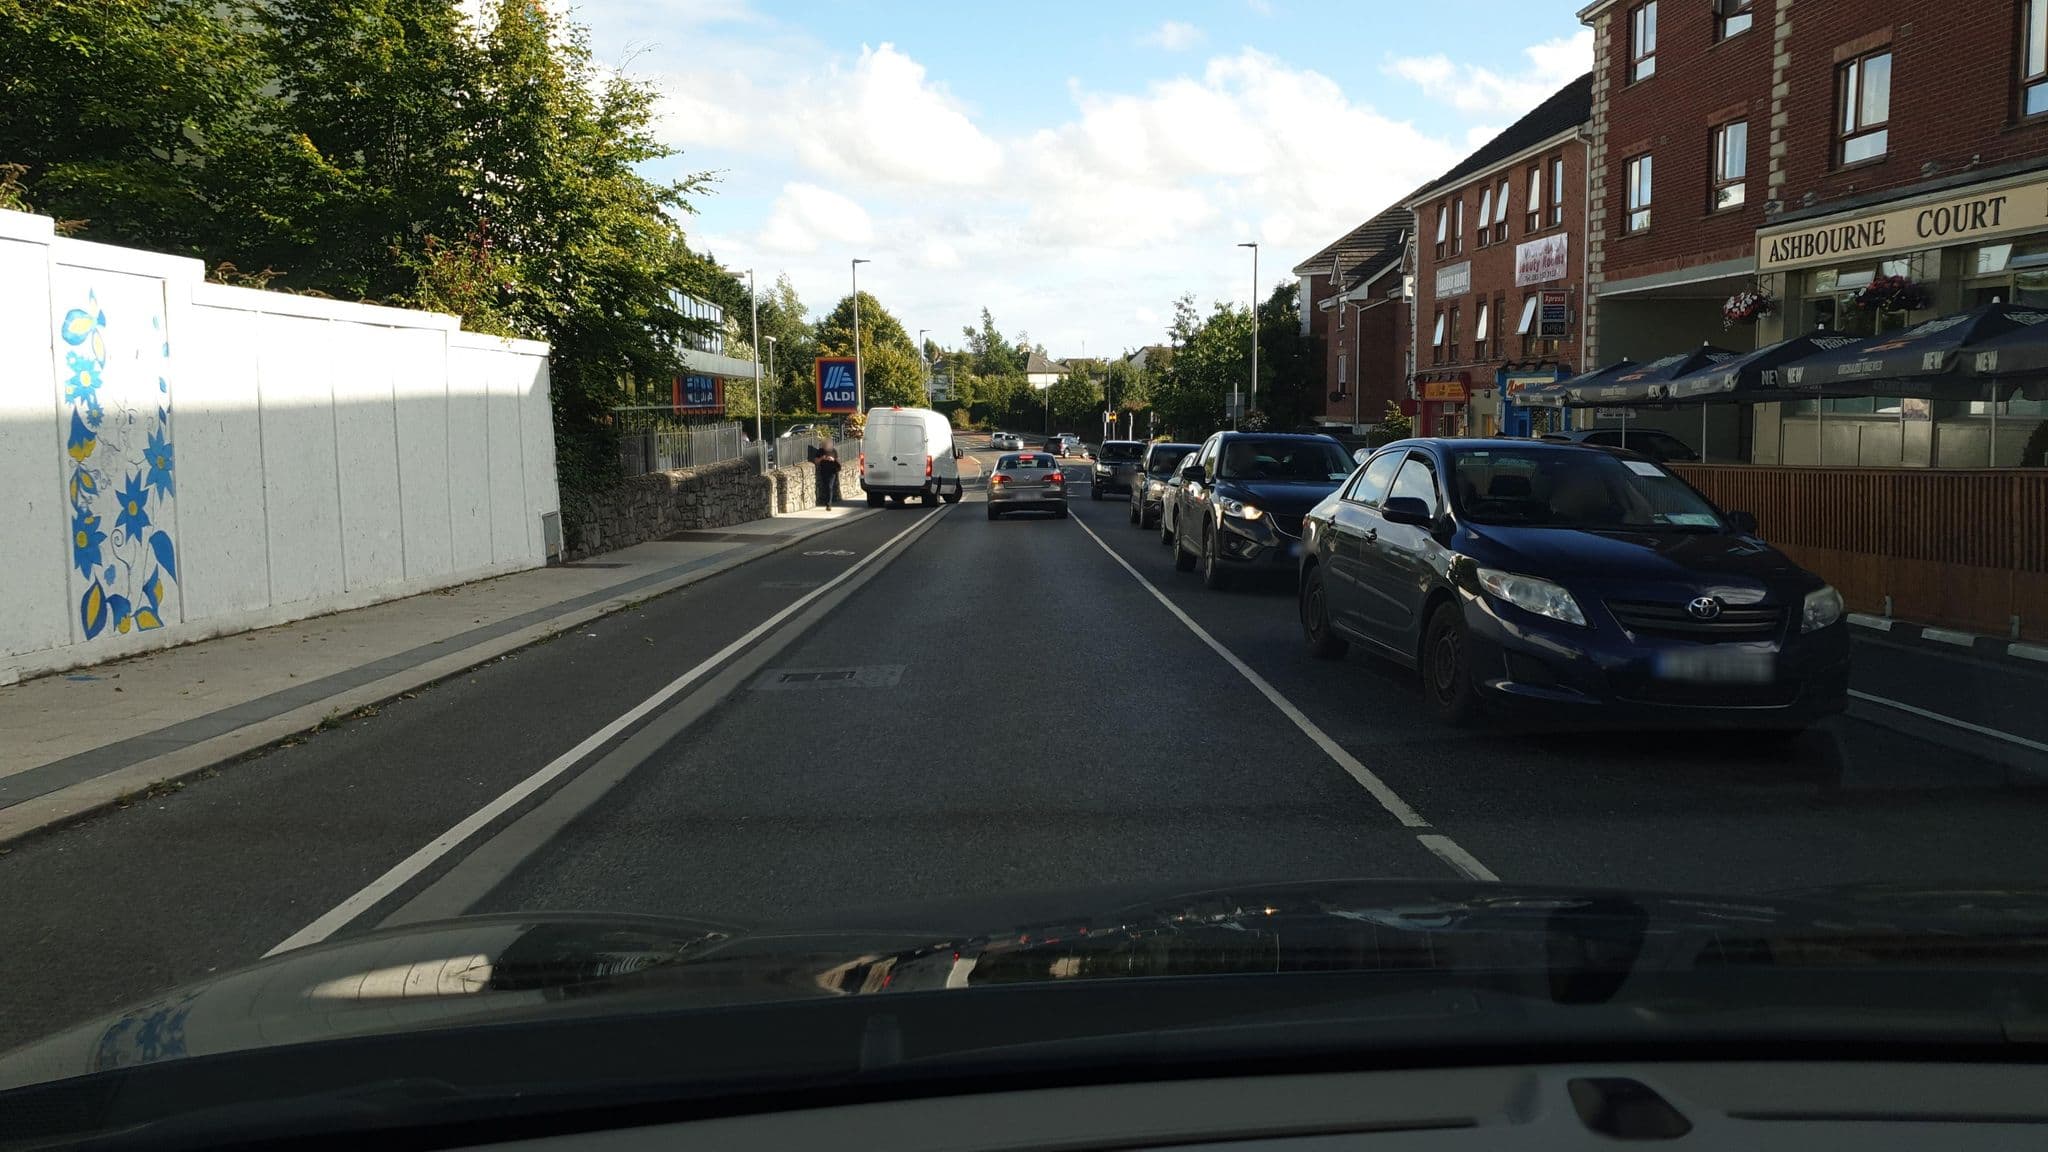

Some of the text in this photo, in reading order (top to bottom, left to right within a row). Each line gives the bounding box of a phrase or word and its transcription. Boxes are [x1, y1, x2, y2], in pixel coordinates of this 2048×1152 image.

[1769, 219, 1886, 263] ASHBOURNE
[1917, 196, 2006, 238] COURT
[1922, 351, 1944, 370] NEW
[1975, 350, 1998, 372] NEW
[1787, 366, 1804, 384] NEW
[823, 391, 855, 402] ALDI
